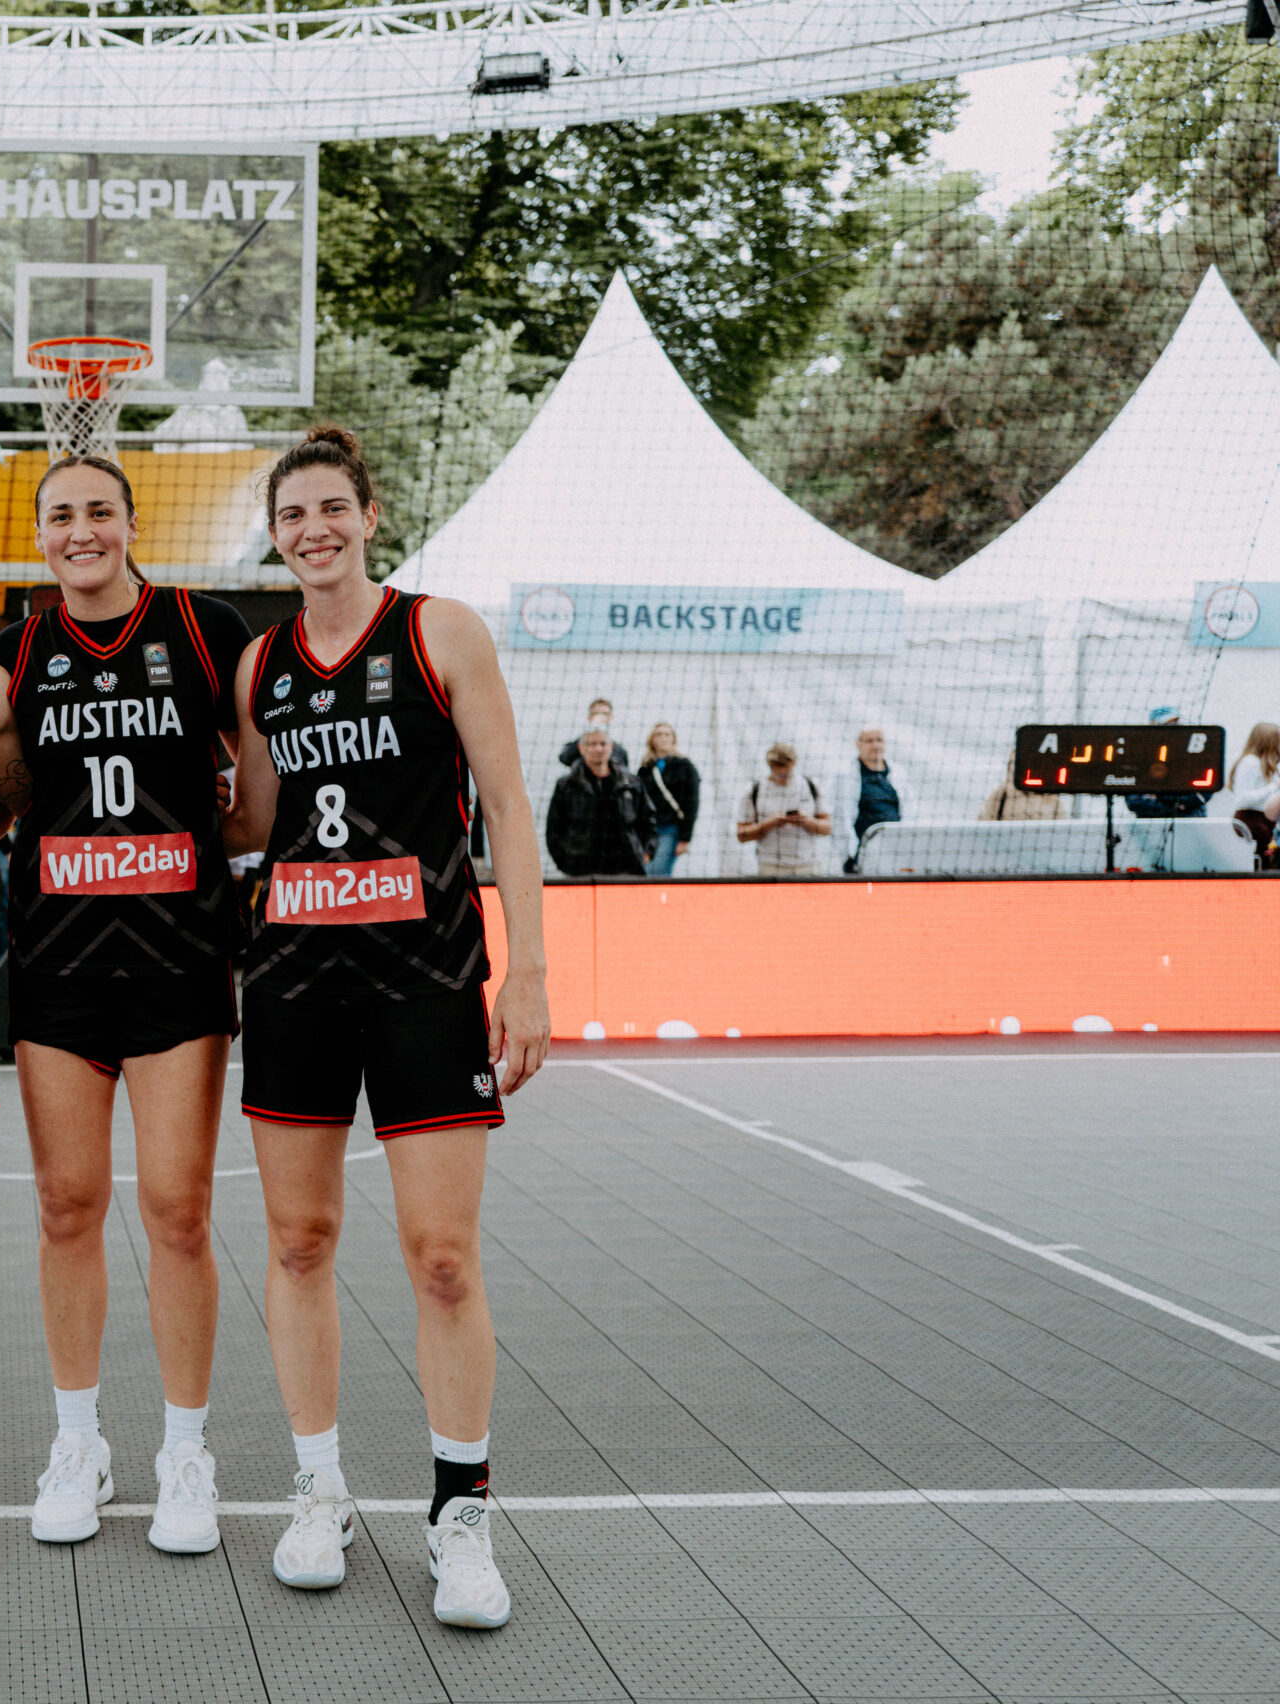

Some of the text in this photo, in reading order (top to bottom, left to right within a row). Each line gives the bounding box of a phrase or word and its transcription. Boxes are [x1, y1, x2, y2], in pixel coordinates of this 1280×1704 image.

[609, 604, 802, 632] BACKSTAGE
[150, 666, 168, 675] FIBA
[37, 682, 68, 692] CRAFT
[370, 680, 388, 690] FIBA
[38, 697, 184, 746] AUSTRIA
[264, 704, 287, 719] CRAFT
[270, 715, 401, 775] AUSTRIA
[1038, 733, 1058, 753] A
[1187, 733, 1207, 753] B
[84, 755, 135, 818] 10
[315, 784, 349, 849] 8
[47, 841, 189, 889] win2day
[275, 868, 414, 918] win2day
